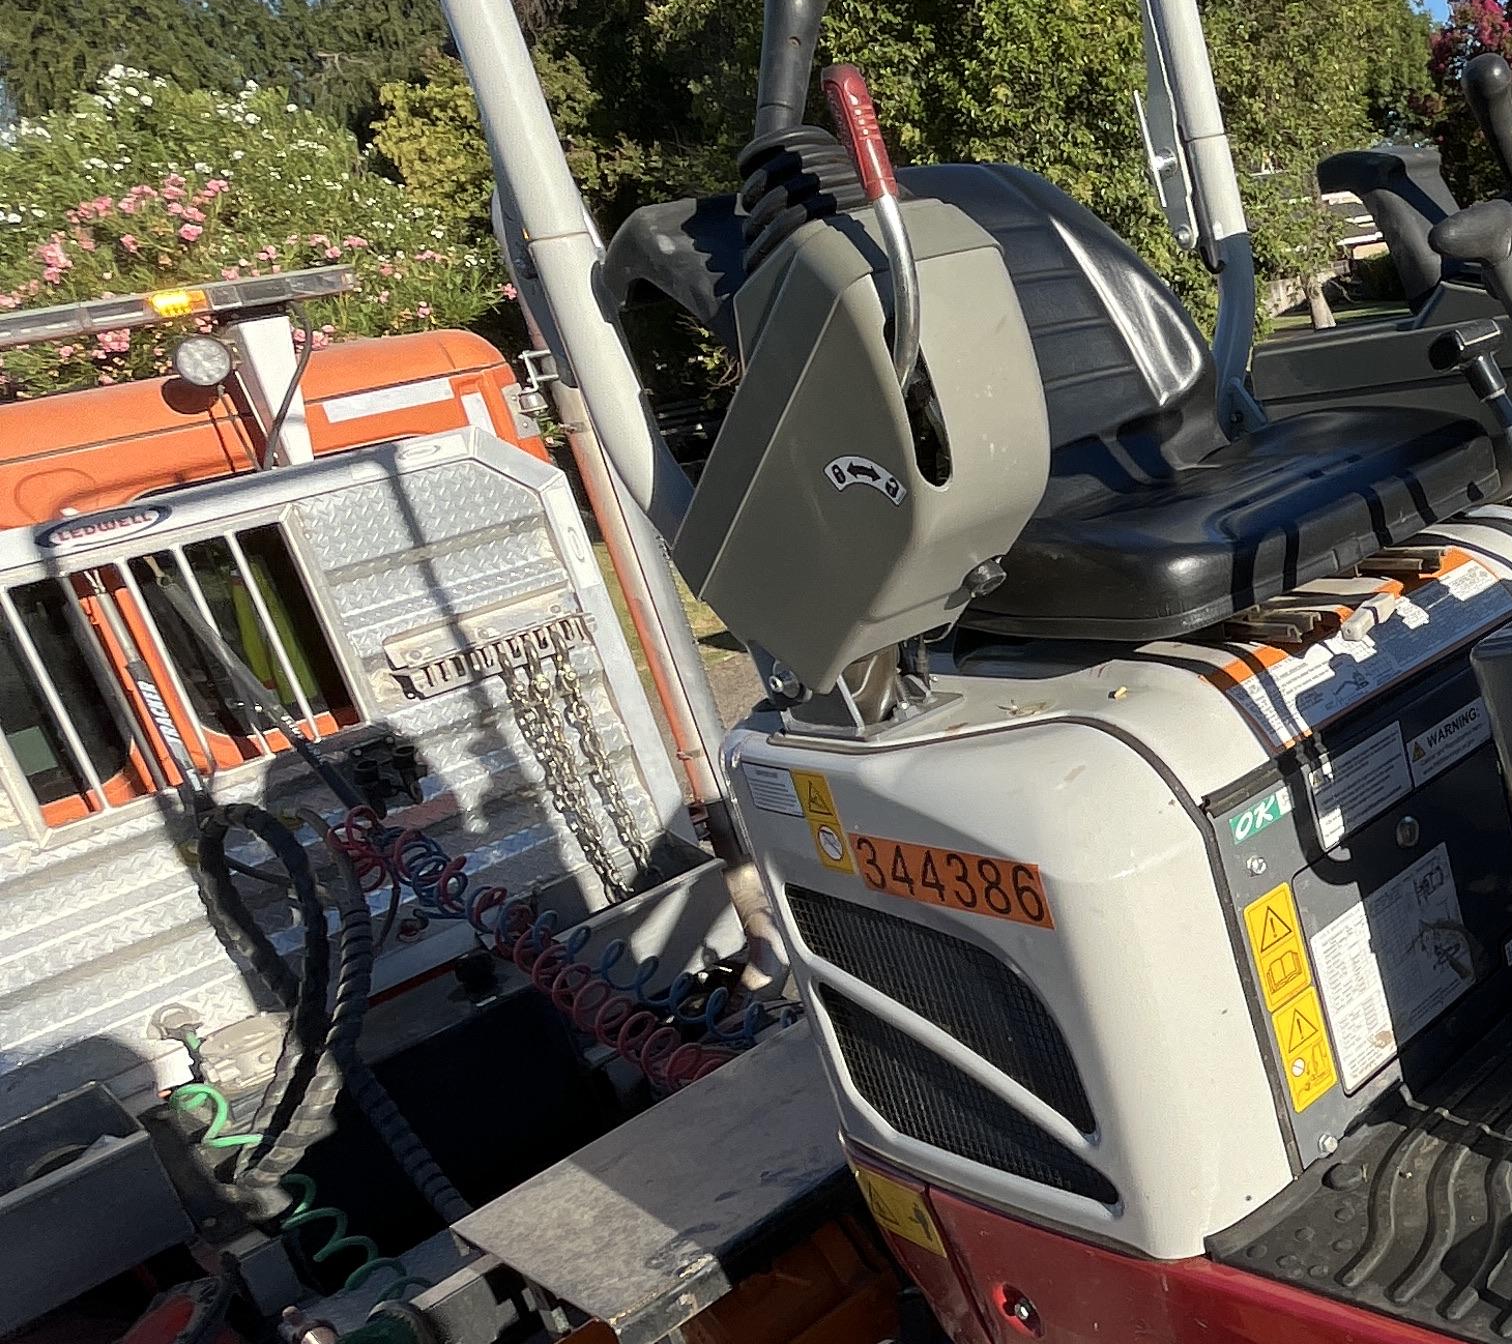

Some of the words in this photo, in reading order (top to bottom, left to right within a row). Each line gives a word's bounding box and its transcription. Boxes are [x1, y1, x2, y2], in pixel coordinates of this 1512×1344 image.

[56, 512, 153, 543] LEDWELL
[1234, 795, 1275, 841] OK
[856, 837, 1045, 922] 344386
